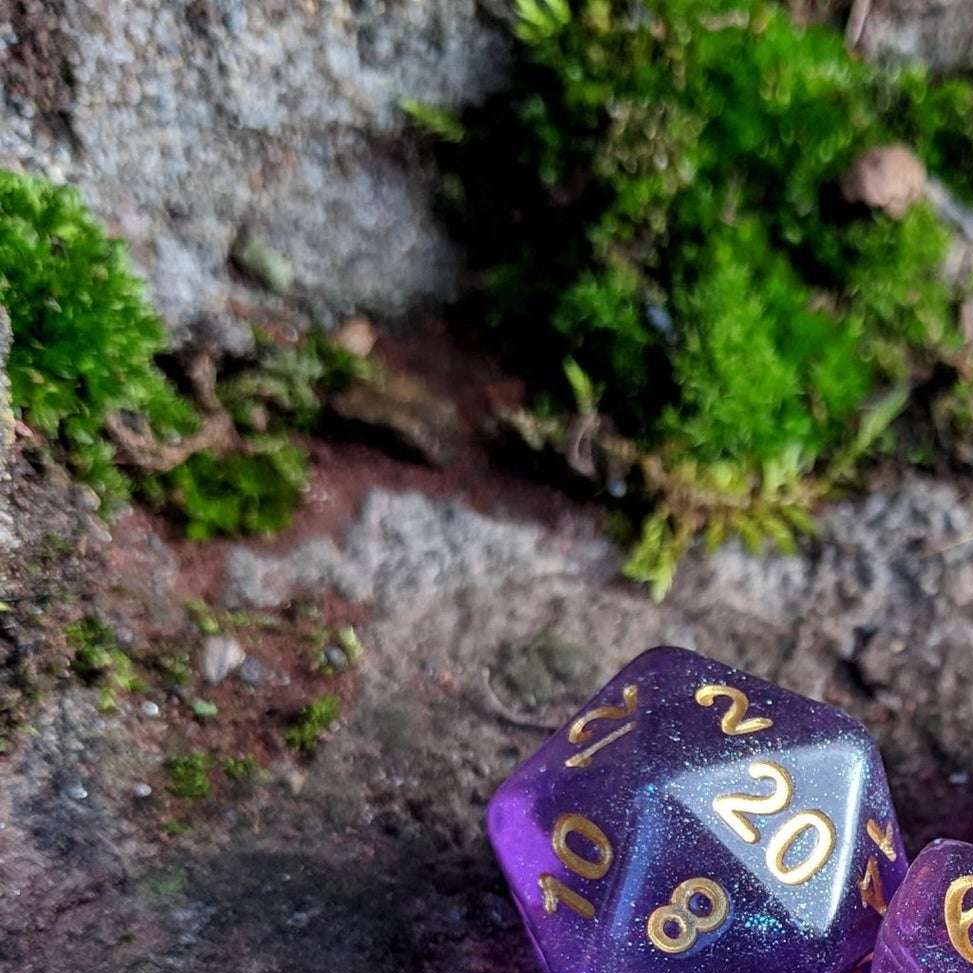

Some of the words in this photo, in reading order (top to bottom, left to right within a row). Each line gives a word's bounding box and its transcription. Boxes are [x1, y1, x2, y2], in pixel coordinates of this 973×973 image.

[696, 684, 773, 735] 2
[538, 813, 614, 919] 10
[712, 760, 836, 886] 20
[647, 877, 730, 953] 8
